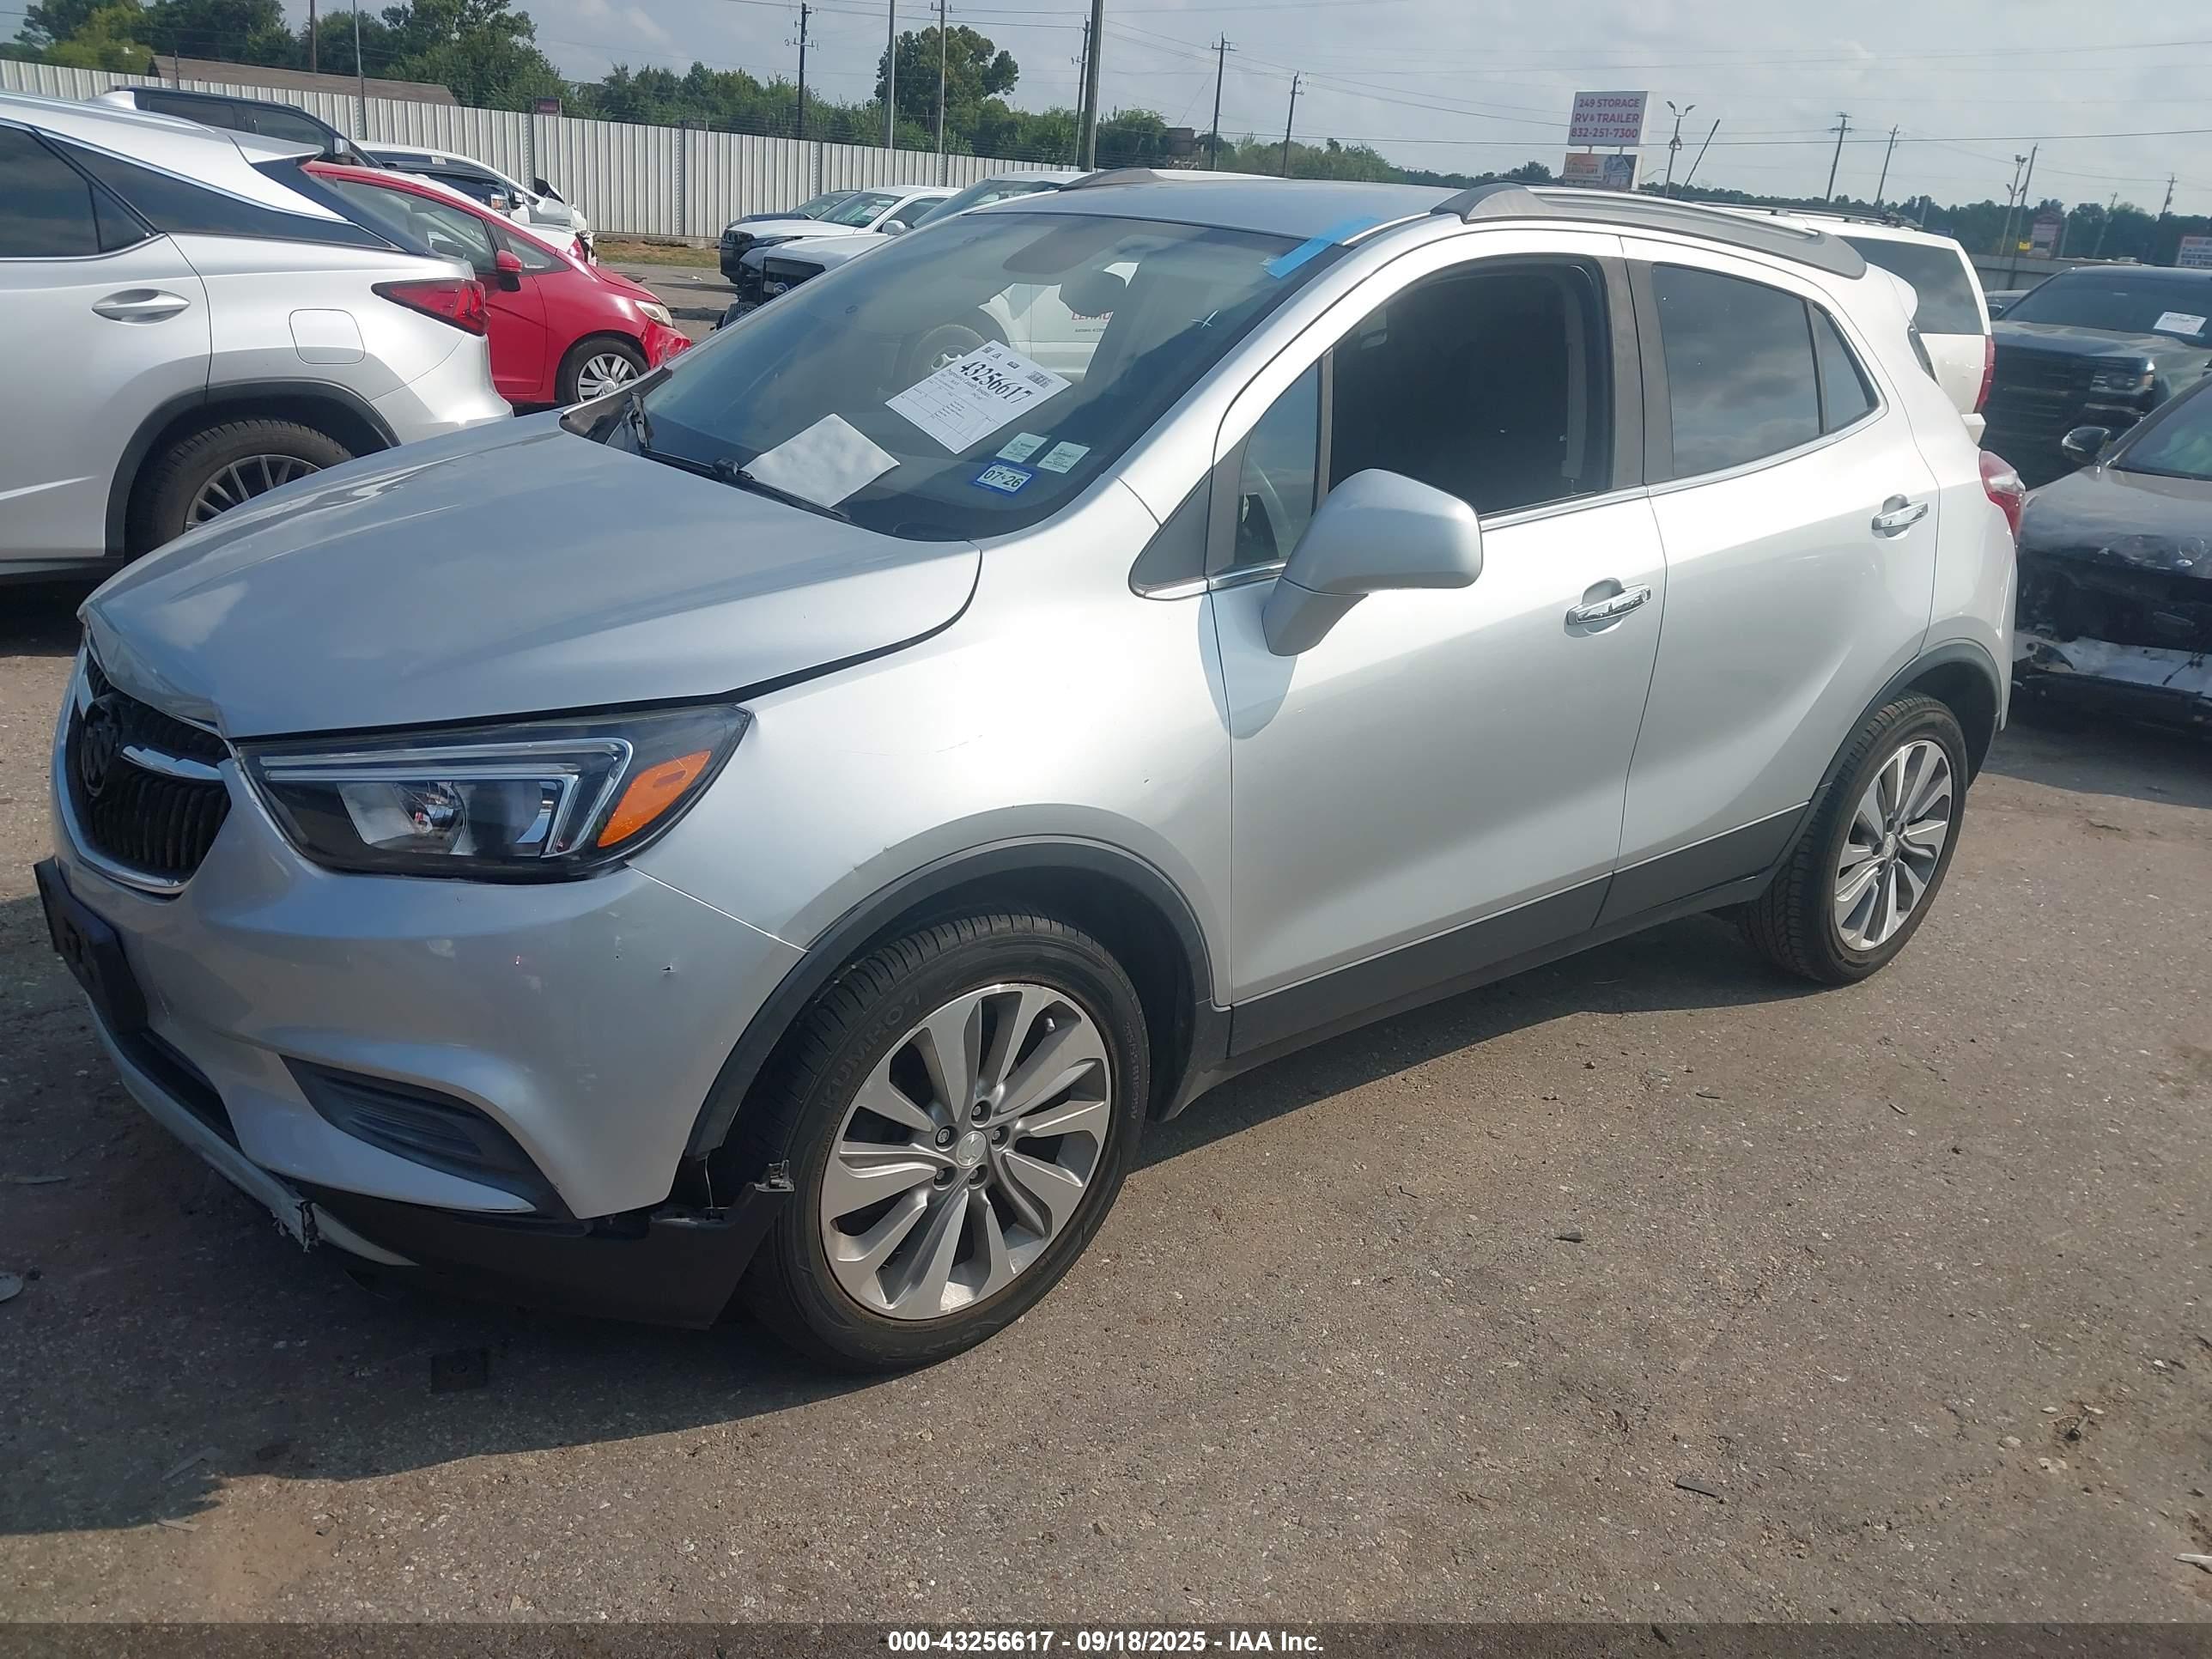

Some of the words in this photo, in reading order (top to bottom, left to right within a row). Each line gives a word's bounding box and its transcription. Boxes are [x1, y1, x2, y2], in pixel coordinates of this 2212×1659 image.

[1578, 99, 1595, 108] 249
[1596, 99, 1640, 108] STORAGE
[1574, 113, 1589, 124] RV
[1596, 113, 1640, 124] TRAILER
[1571, 128, 1638, 138] 832-251-7300
[960, 361, 1035, 404] 43256617
[983, 470, 1003, 481] 07
[1003, 475, 1024, 488] 26
